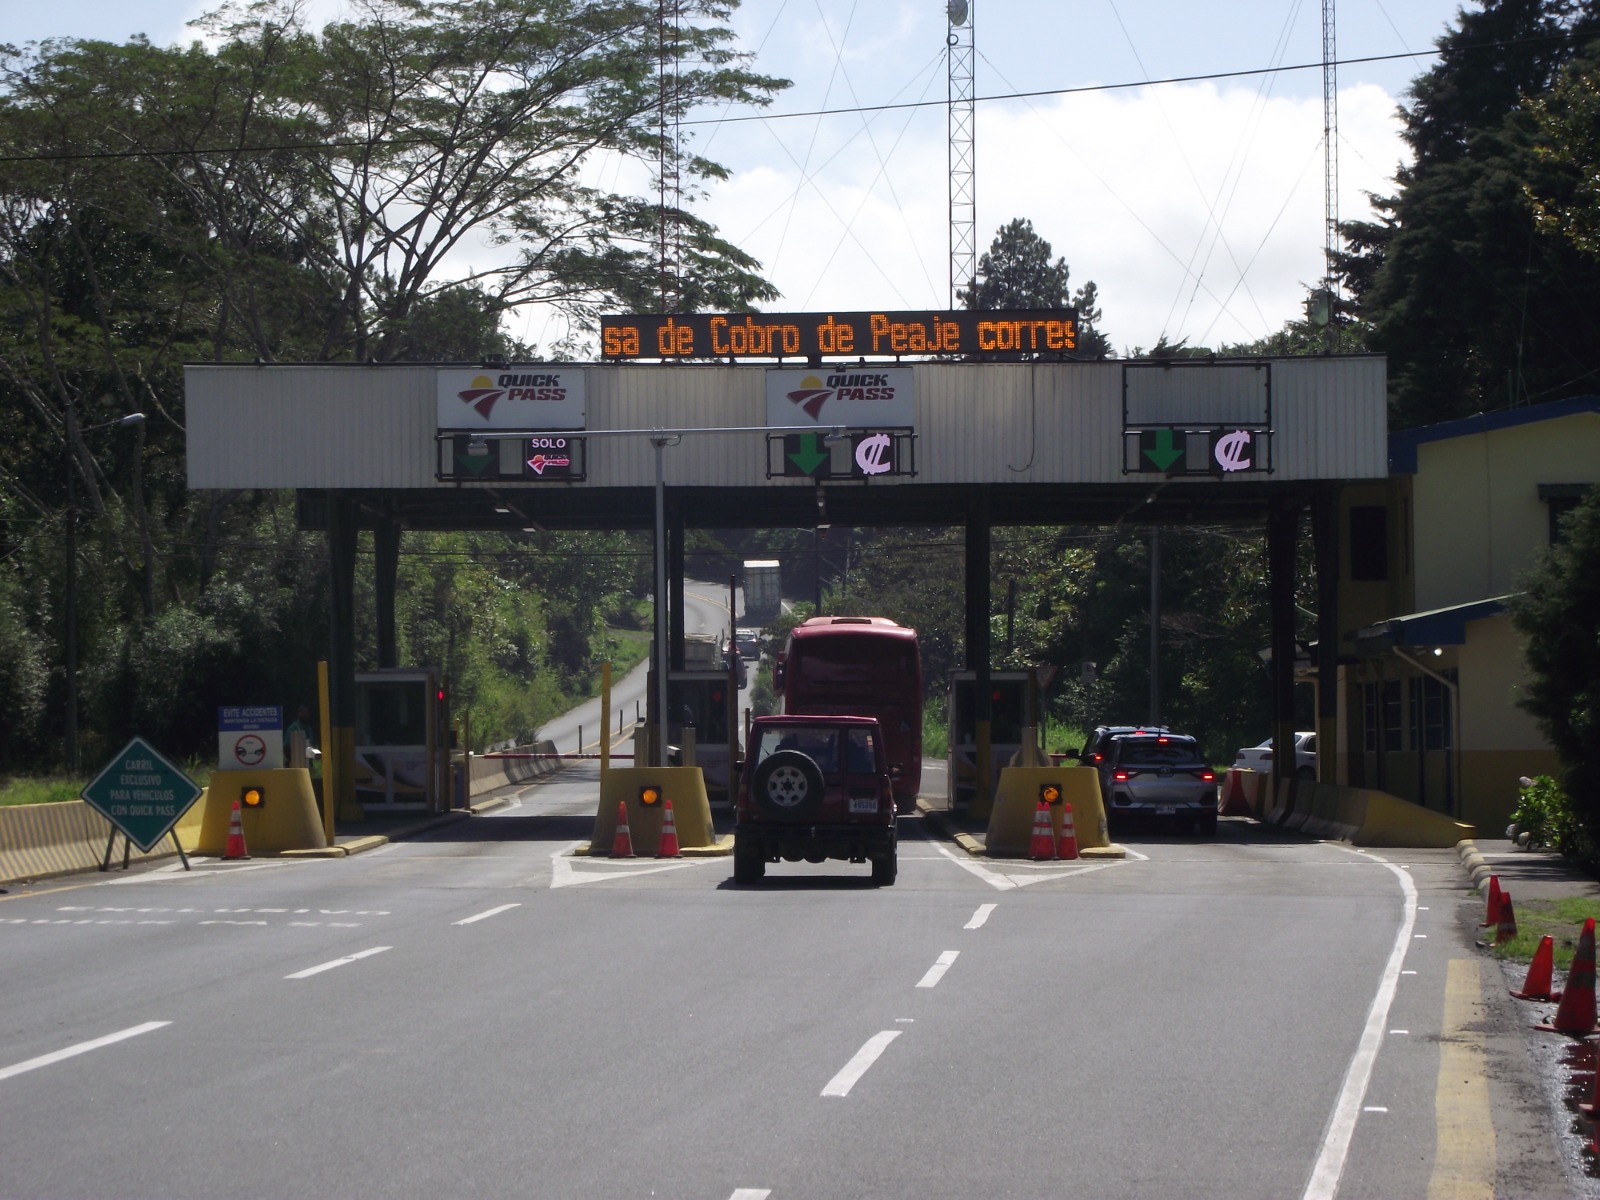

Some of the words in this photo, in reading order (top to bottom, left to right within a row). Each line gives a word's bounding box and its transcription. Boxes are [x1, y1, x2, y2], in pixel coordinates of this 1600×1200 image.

[657, 317, 694, 355] de
[709, 316, 801, 355] Cobro
[816, 315, 854, 353] de
[870, 313, 960, 352] Peaje
[497, 374, 561, 389] QUICK
[826, 374, 889, 389] QUICK
[507, 388, 567, 401] PASS
[836, 387, 895, 401] PASS
[531, 438, 566, 449] SOLO
[223, 708, 240, 718] EVITE
[242, 707, 278, 717] ACCIDENTES
[125, 760, 154, 770] CARRIL
[120, 774, 162, 786] EXCLUSIVO
[110, 789, 131, 801] PARA
[132, 789, 175, 801] VEHICULOS
[111, 804, 128, 816] CON
[129, 804, 154, 816] QUICK
[155, 804, 176, 816] PASS
